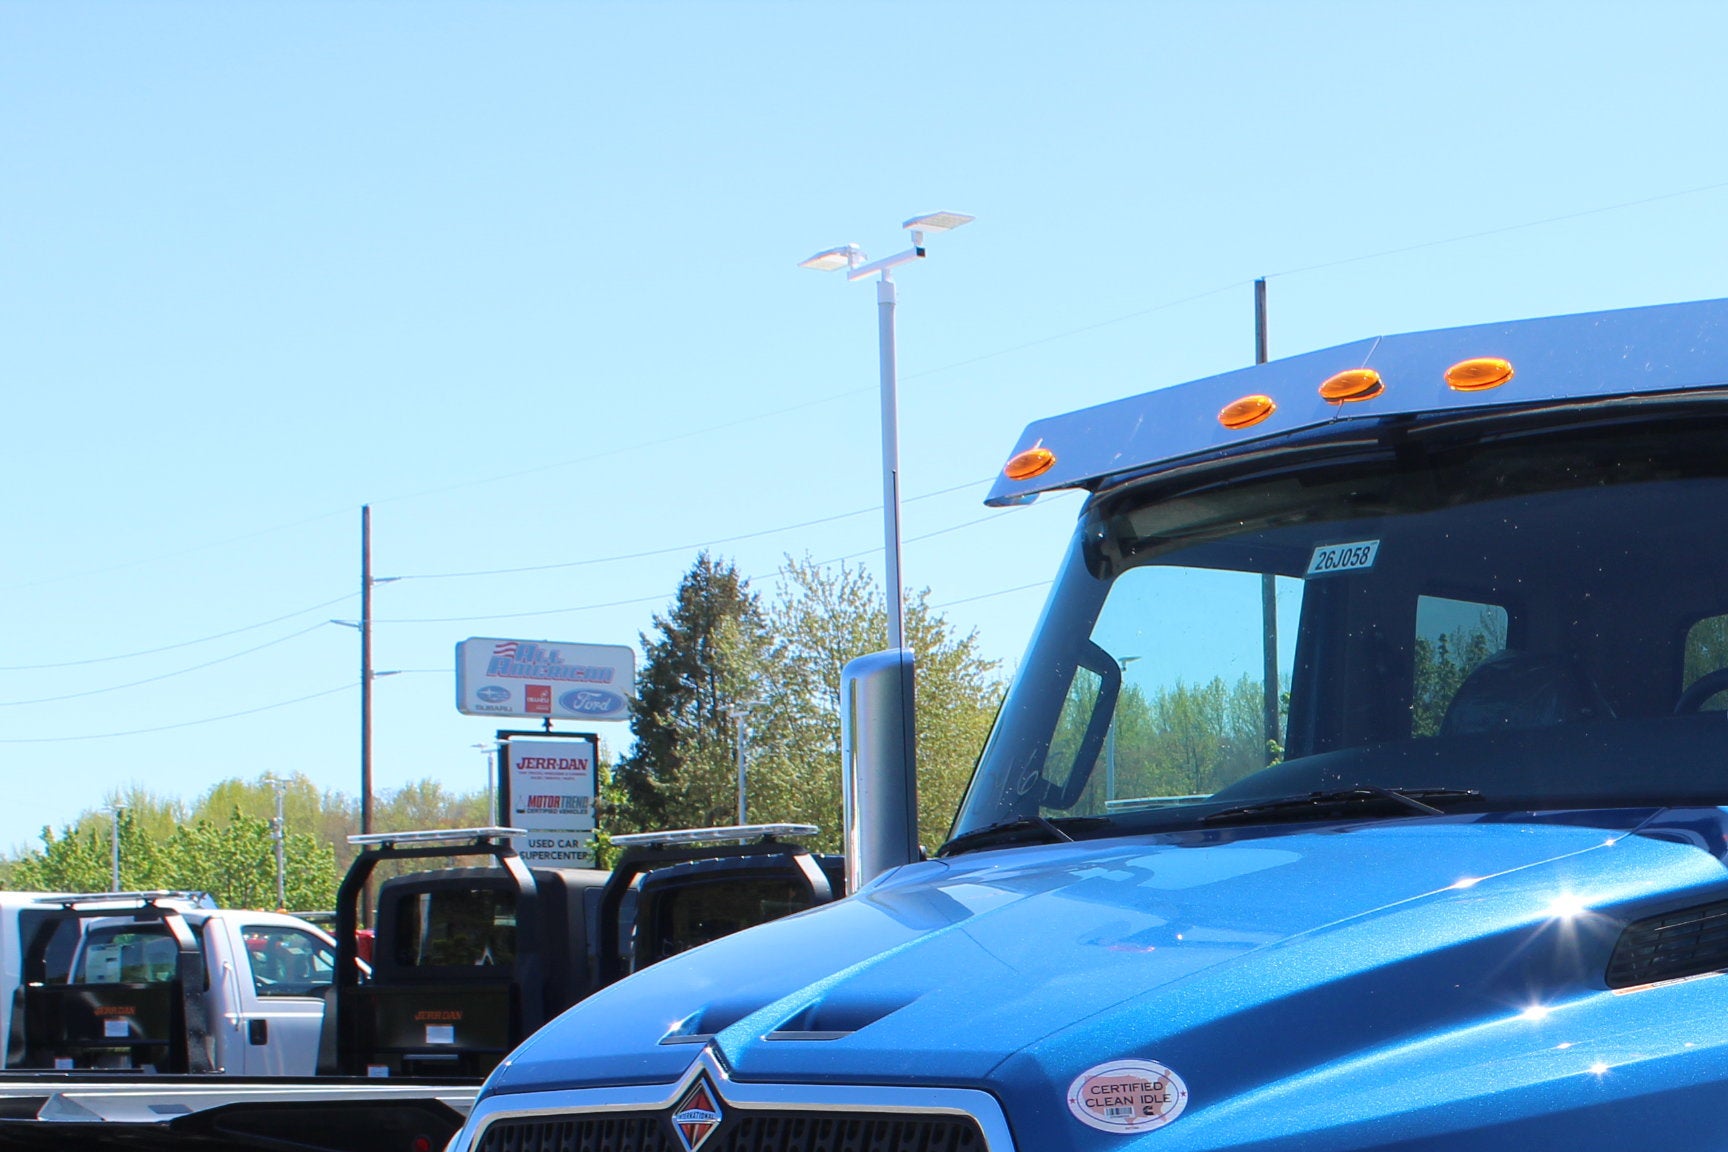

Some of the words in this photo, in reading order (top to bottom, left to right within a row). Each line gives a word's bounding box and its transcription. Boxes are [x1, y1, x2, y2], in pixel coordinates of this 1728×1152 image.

[1315, 546, 1371, 571] 26J058
[573, 691, 611, 711] Ford
[528, 839, 555, 848] USED
[557, 839, 579, 848] CAR
[1090, 1081, 1164, 1095] CERTIFIED
[1085, 1095, 1134, 1108] CLEAN
[1140, 1093, 1172, 1104] IDLE
